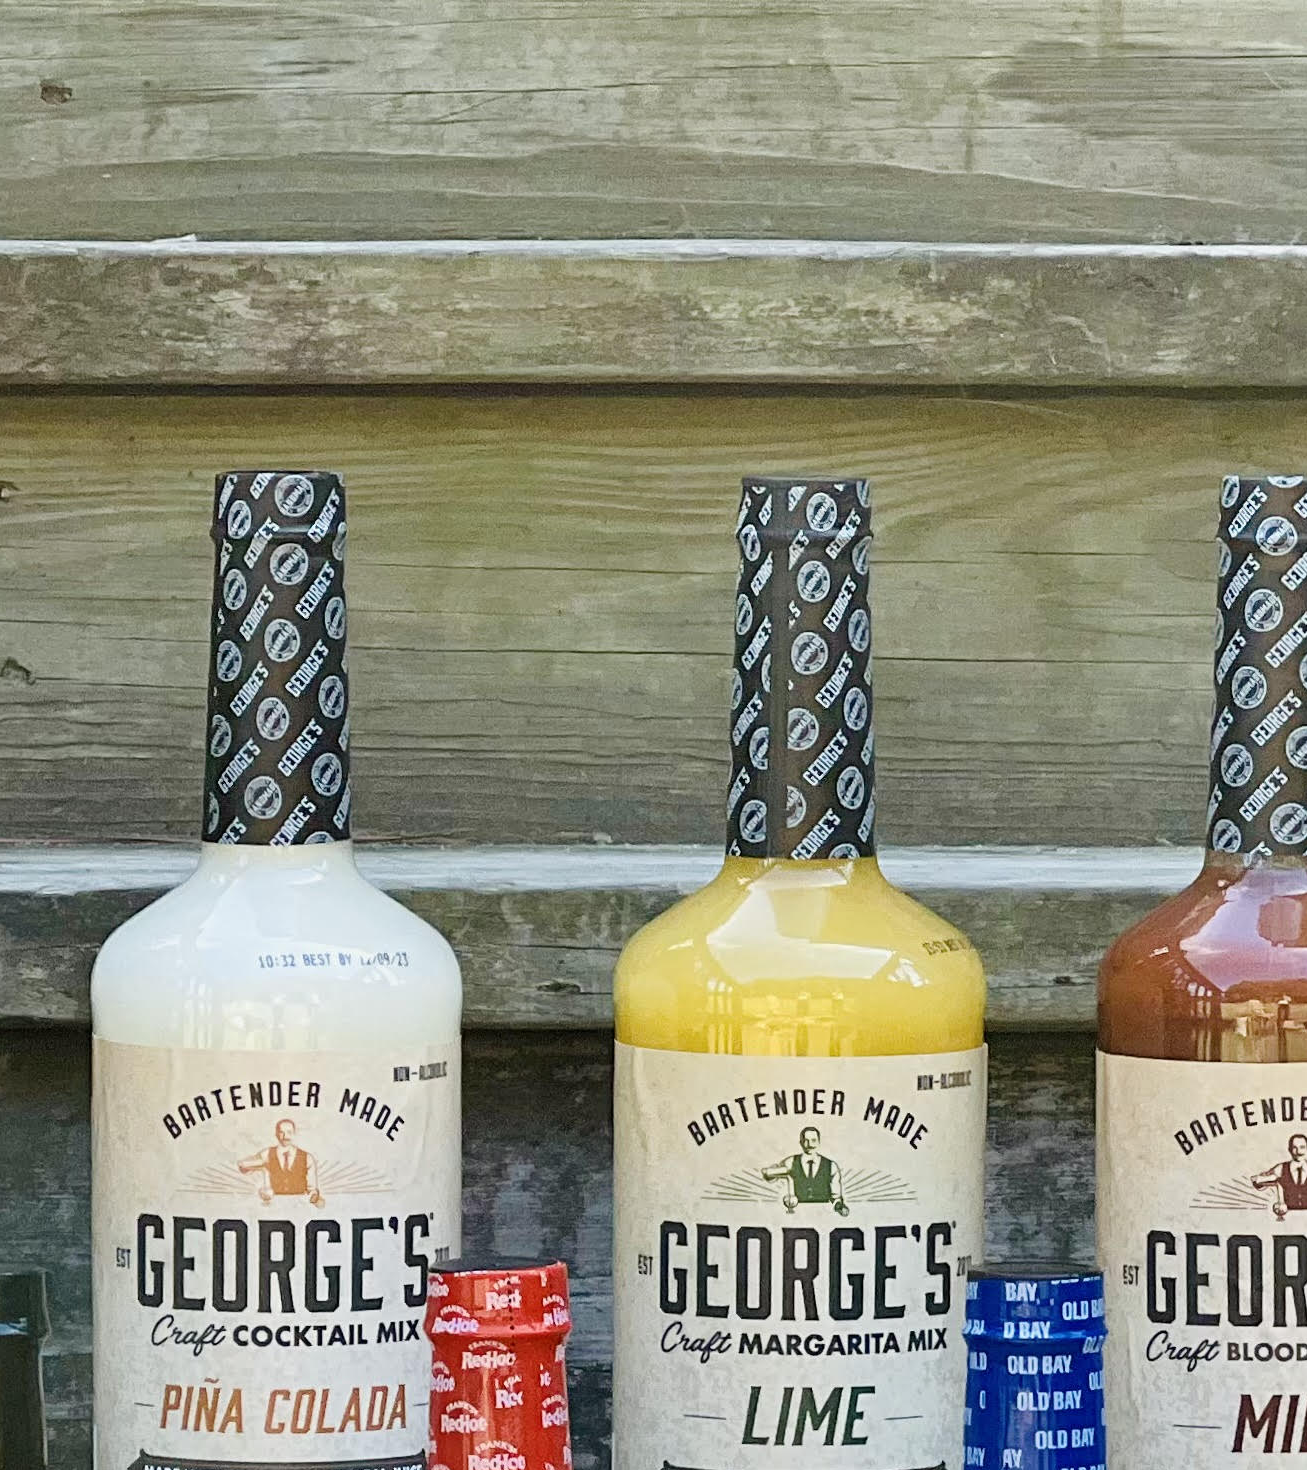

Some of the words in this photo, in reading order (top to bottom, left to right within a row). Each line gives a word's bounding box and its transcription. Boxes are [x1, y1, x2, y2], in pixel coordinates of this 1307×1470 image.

[258, 955, 295, 968] 10:32
[302, 953, 330, 966] BEST
[162, 1081, 319, 1140] BARTENDER
[339, 1088, 407, 1141] MADE
[687, 1089, 845, 1147] BARTENDER
[864, 1097, 928, 1150] MADE
[138, 1213, 429, 1314] GEORGE'S
[659, 1220, 952, 1320] GEORGE'S
[151, 1314, 227, 1356] Craft
[233, 1324, 367, 1346] COCKTAIL
[376, 1320, 421, 1343] MIX
[660, 1321, 732, 1363] Craft
[738, 1333, 900, 1356] MARGARITA
[908, 1328, 947, 1352] MIX
[1146, 1330, 1221, 1373] Craft
[160, 1378, 243, 1434] PIÑA
[264, 1384, 406, 1434] COLADA
[742, 1386, 875, 1446] LIME
